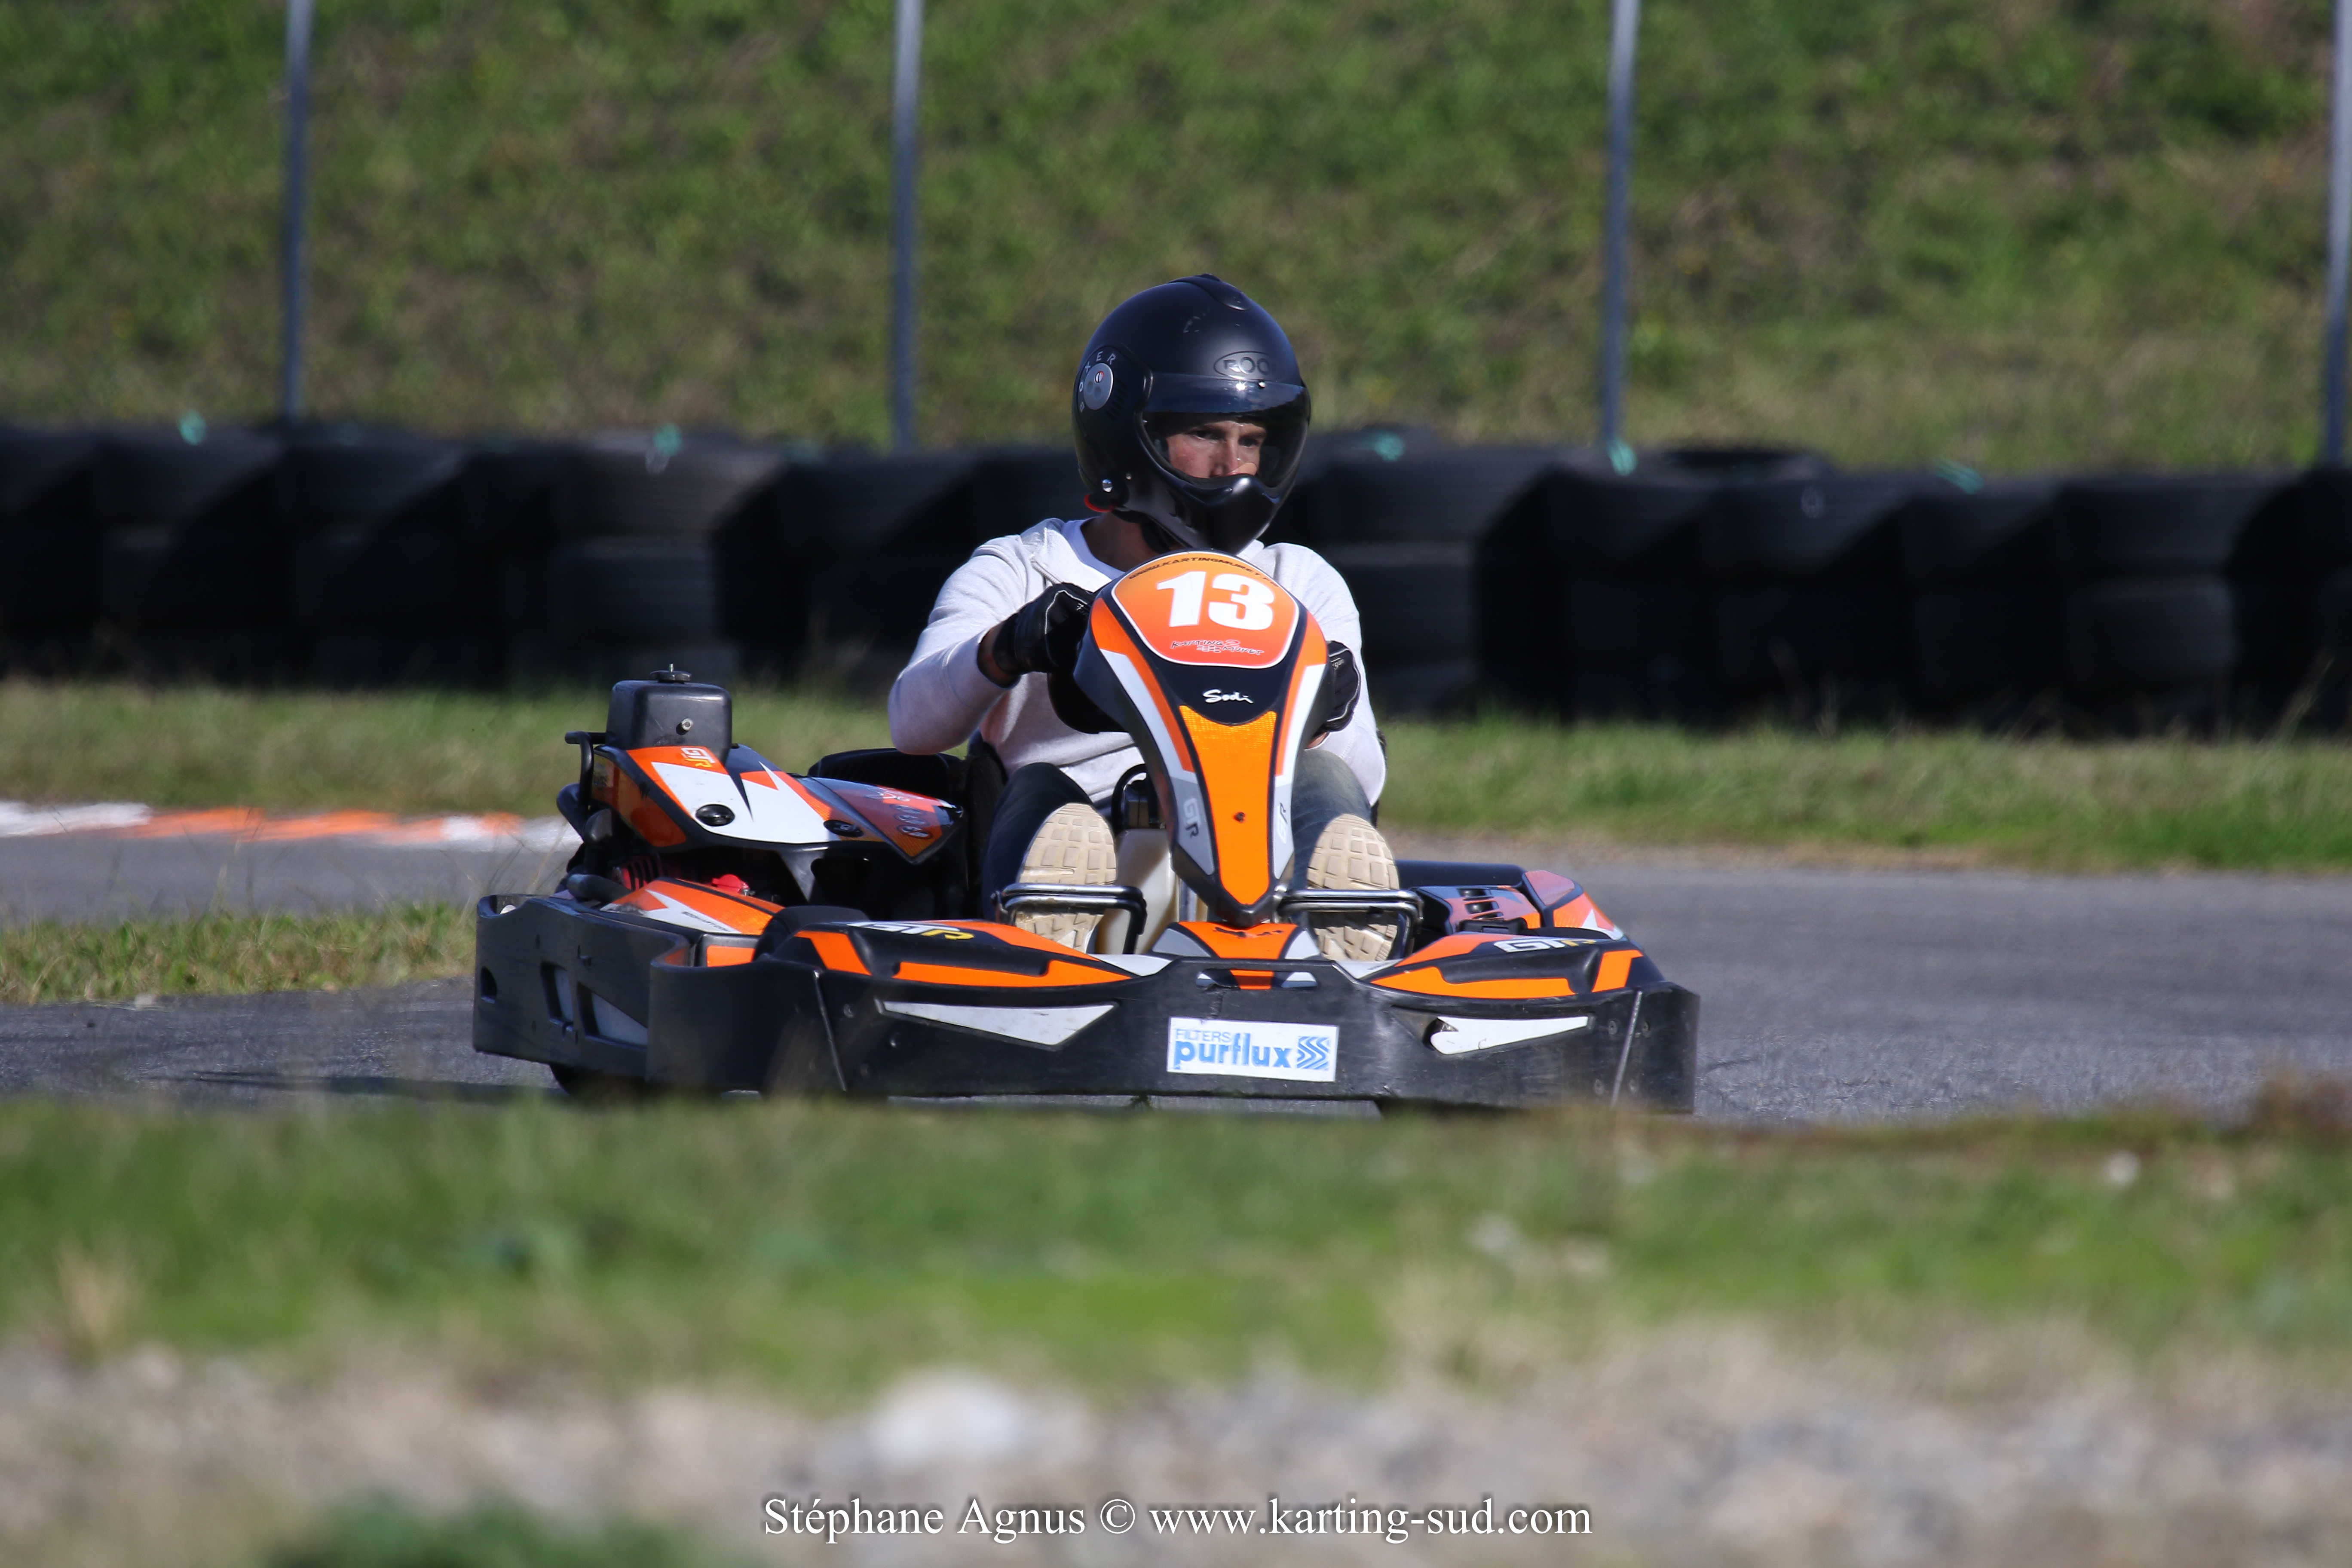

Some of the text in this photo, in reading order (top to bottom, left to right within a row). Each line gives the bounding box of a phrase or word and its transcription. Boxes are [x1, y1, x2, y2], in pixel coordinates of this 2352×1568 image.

[1156, 570, 1275, 630] 13
[1170, 640, 1224, 649] KARTING
[1202, 689, 1254, 704] Sodi
[1176, 1028, 1232, 1043] FILTERS
[1173, 1032, 1293, 1070] purflux
